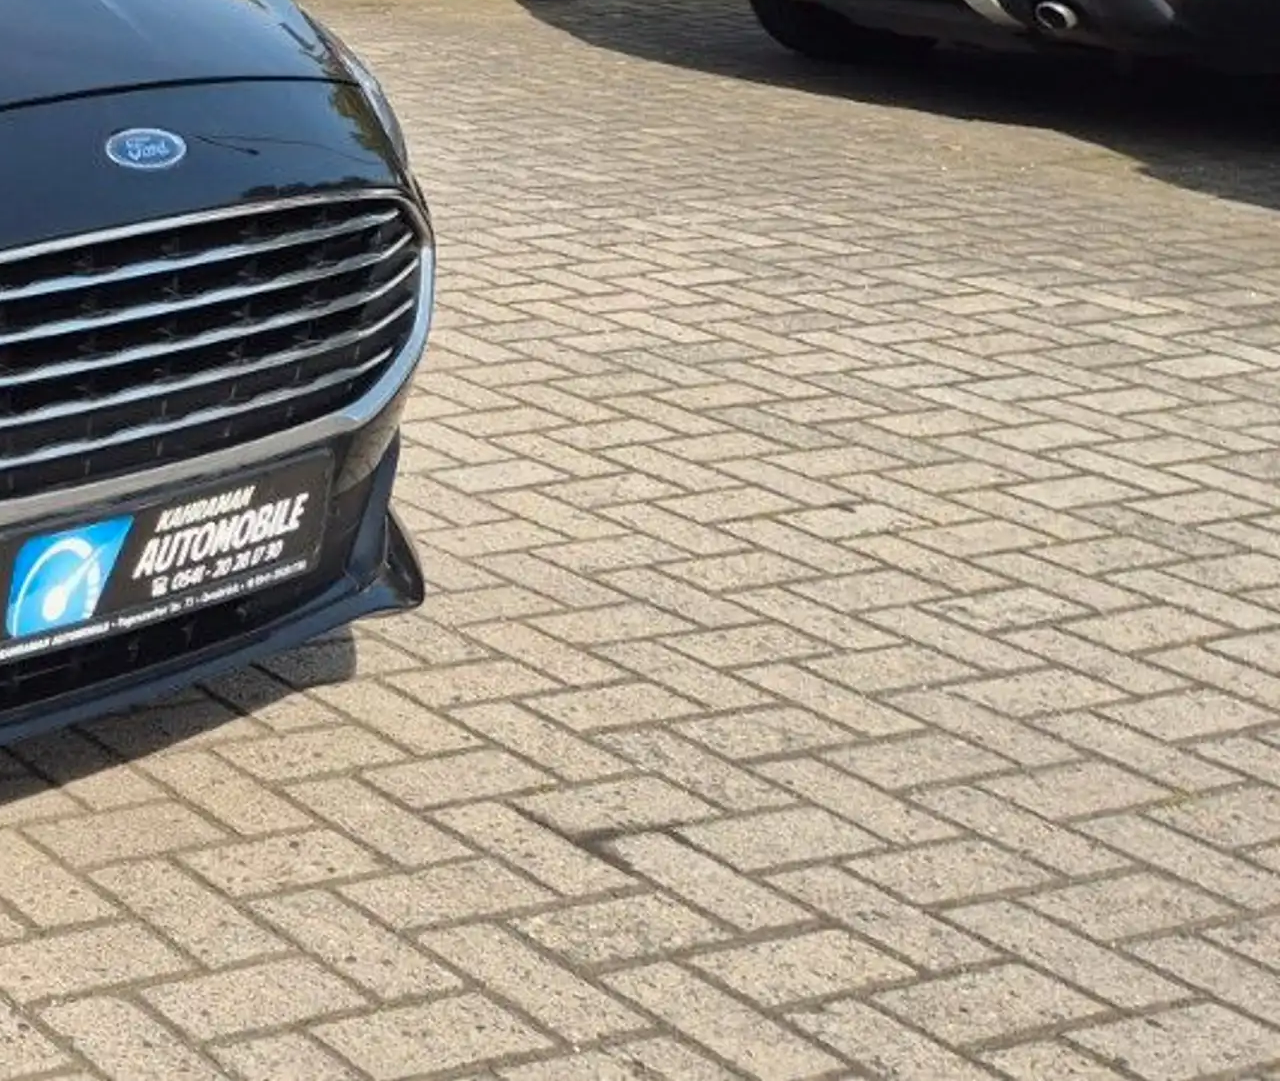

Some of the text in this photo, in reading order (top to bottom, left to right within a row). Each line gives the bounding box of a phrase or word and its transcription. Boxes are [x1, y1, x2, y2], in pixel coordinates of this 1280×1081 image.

[124, 136, 170, 161] Ford
[154, 485, 257, 533] KAHRAMAN
[132, 493, 310, 579] AUTOMOBILE
